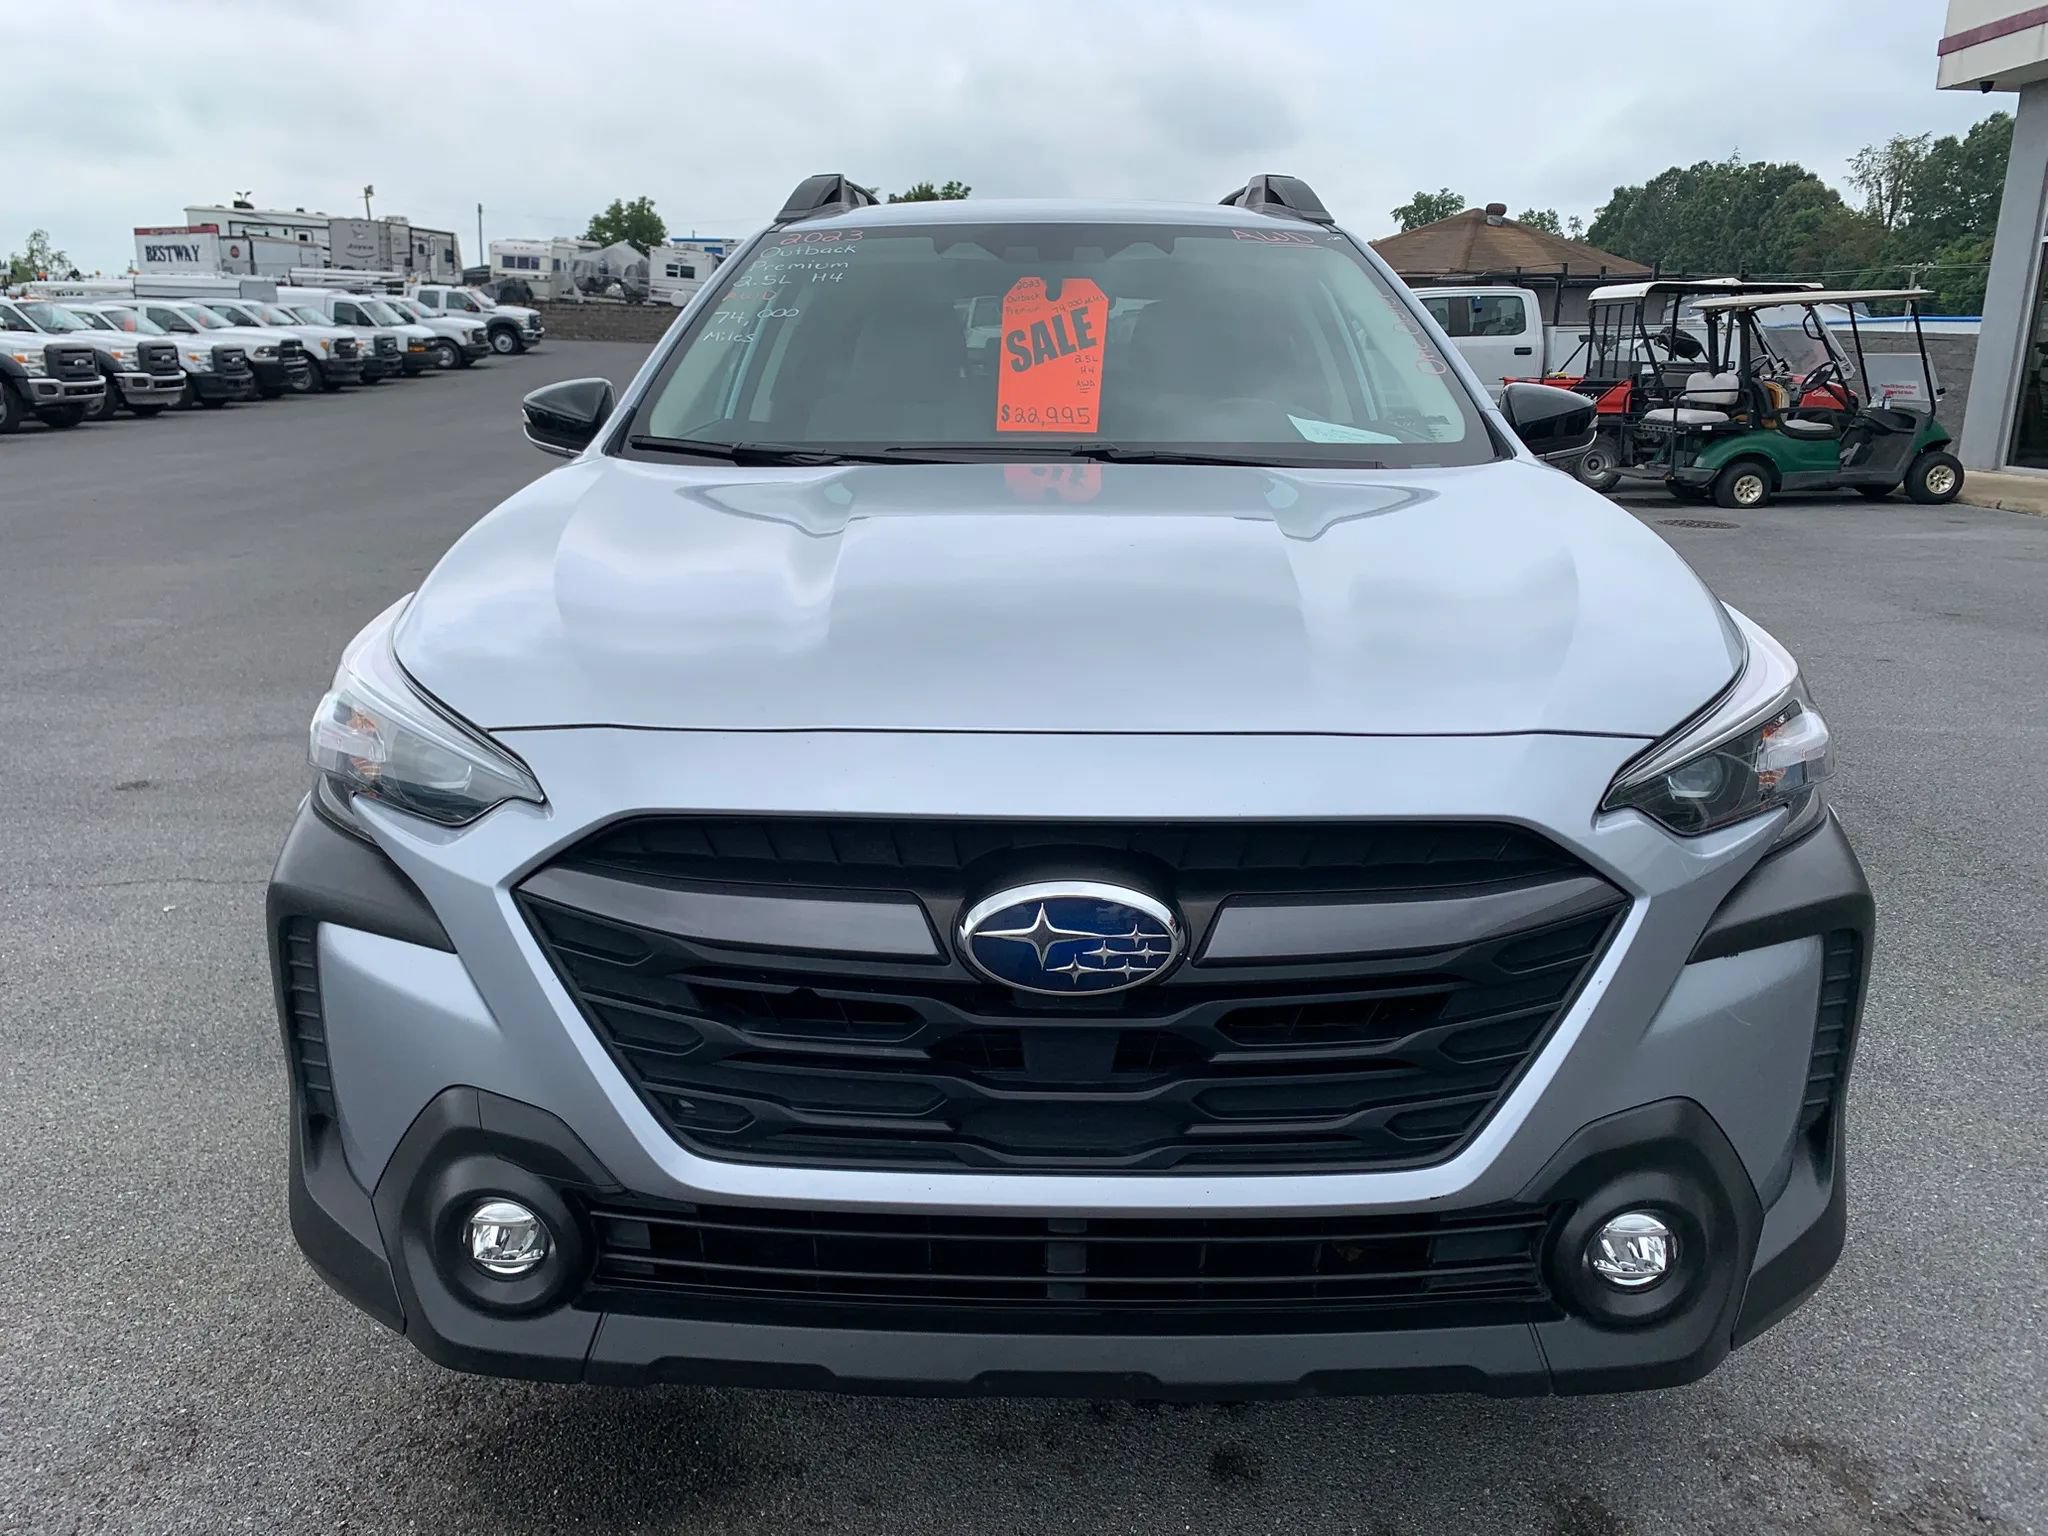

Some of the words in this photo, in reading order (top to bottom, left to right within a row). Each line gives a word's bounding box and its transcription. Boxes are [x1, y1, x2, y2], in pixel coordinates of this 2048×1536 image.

[780, 230, 864, 245] 2023
[1231, 229, 1314, 243] AWD
[145, 245, 200, 262] BESTWAY
[760, 246, 857, 258] Outback
[750, 260, 849, 271] Premium
[733, 275, 793, 288] 2.5L
[812, 272, 844, 283] H4
[1017, 280, 1041, 289] 2023
[714, 308, 800, 327] 74,000
[703, 331, 756, 343] Miles
[1006, 316, 1097, 373] SALE
